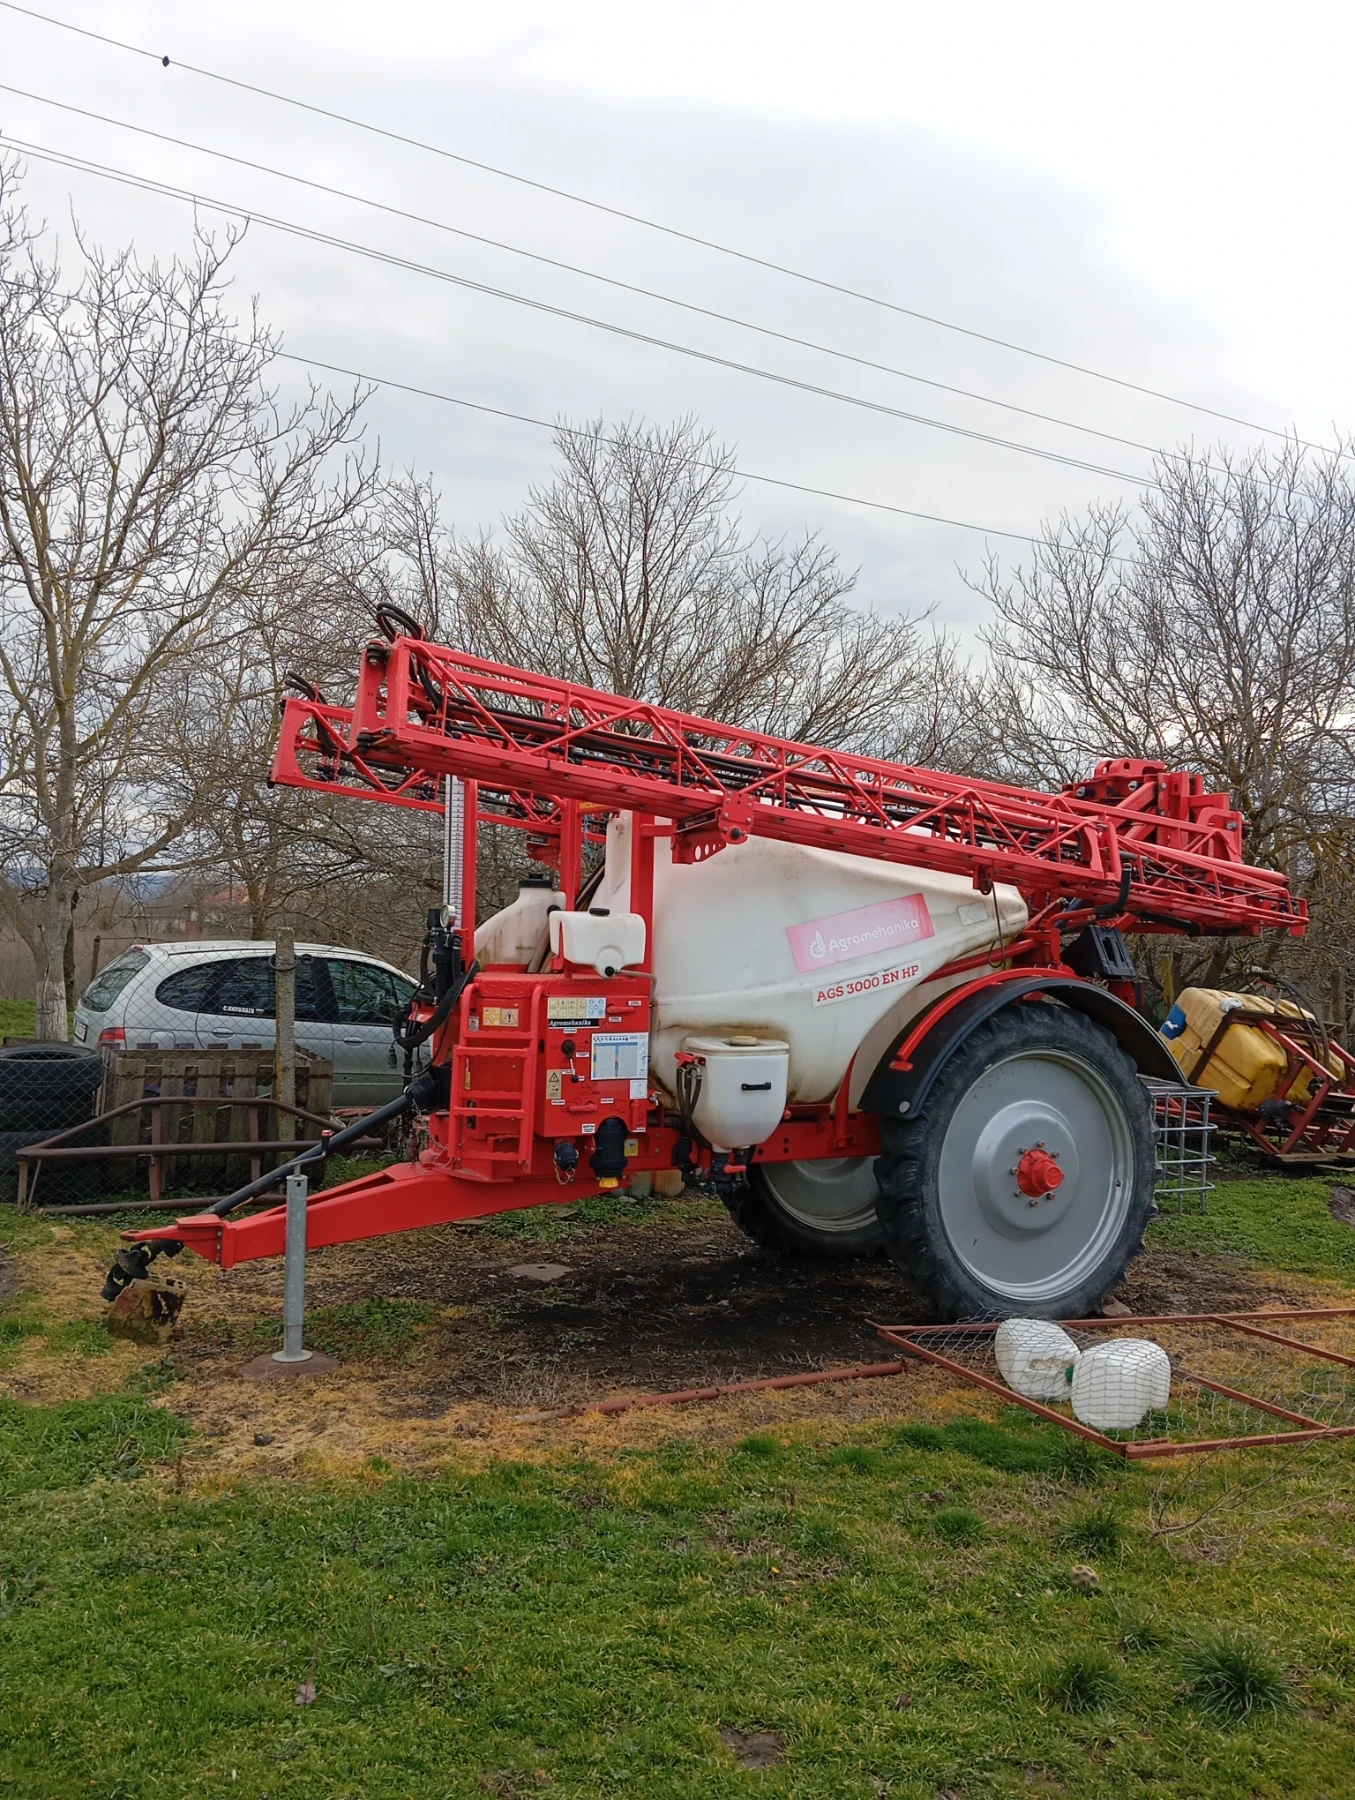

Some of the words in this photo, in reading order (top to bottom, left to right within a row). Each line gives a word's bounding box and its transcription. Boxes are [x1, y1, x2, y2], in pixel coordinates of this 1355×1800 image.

[830, 919, 919, 951] Agromehanika
[816, 986, 844, 1002] AGS
[847, 977, 879, 994] 3000
[882, 971, 899, 985] EN
[902, 964, 919, 979] HP
